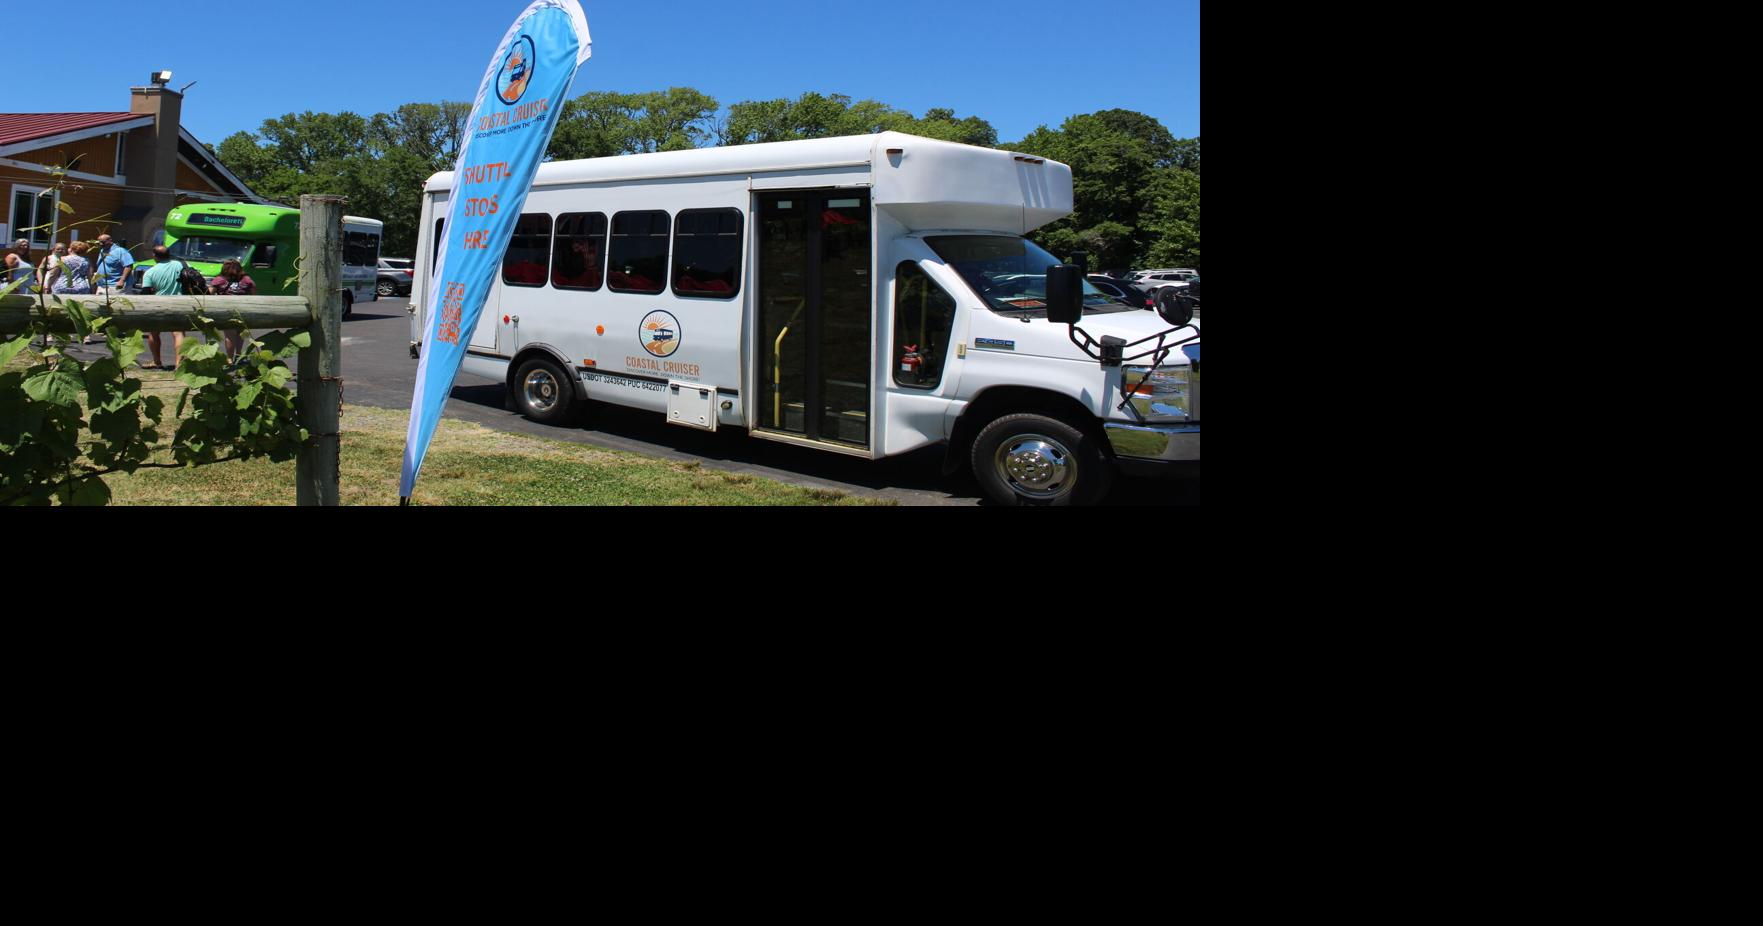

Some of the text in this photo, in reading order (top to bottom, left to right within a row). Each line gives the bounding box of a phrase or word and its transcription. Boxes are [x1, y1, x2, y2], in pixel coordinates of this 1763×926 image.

[626, 356, 700, 376] COASTAL CRUISER
[582, 372, 603, 382] USDOT
[627, 379, 641, 389] PUC
[641, 382, 667, 393] 6422077
